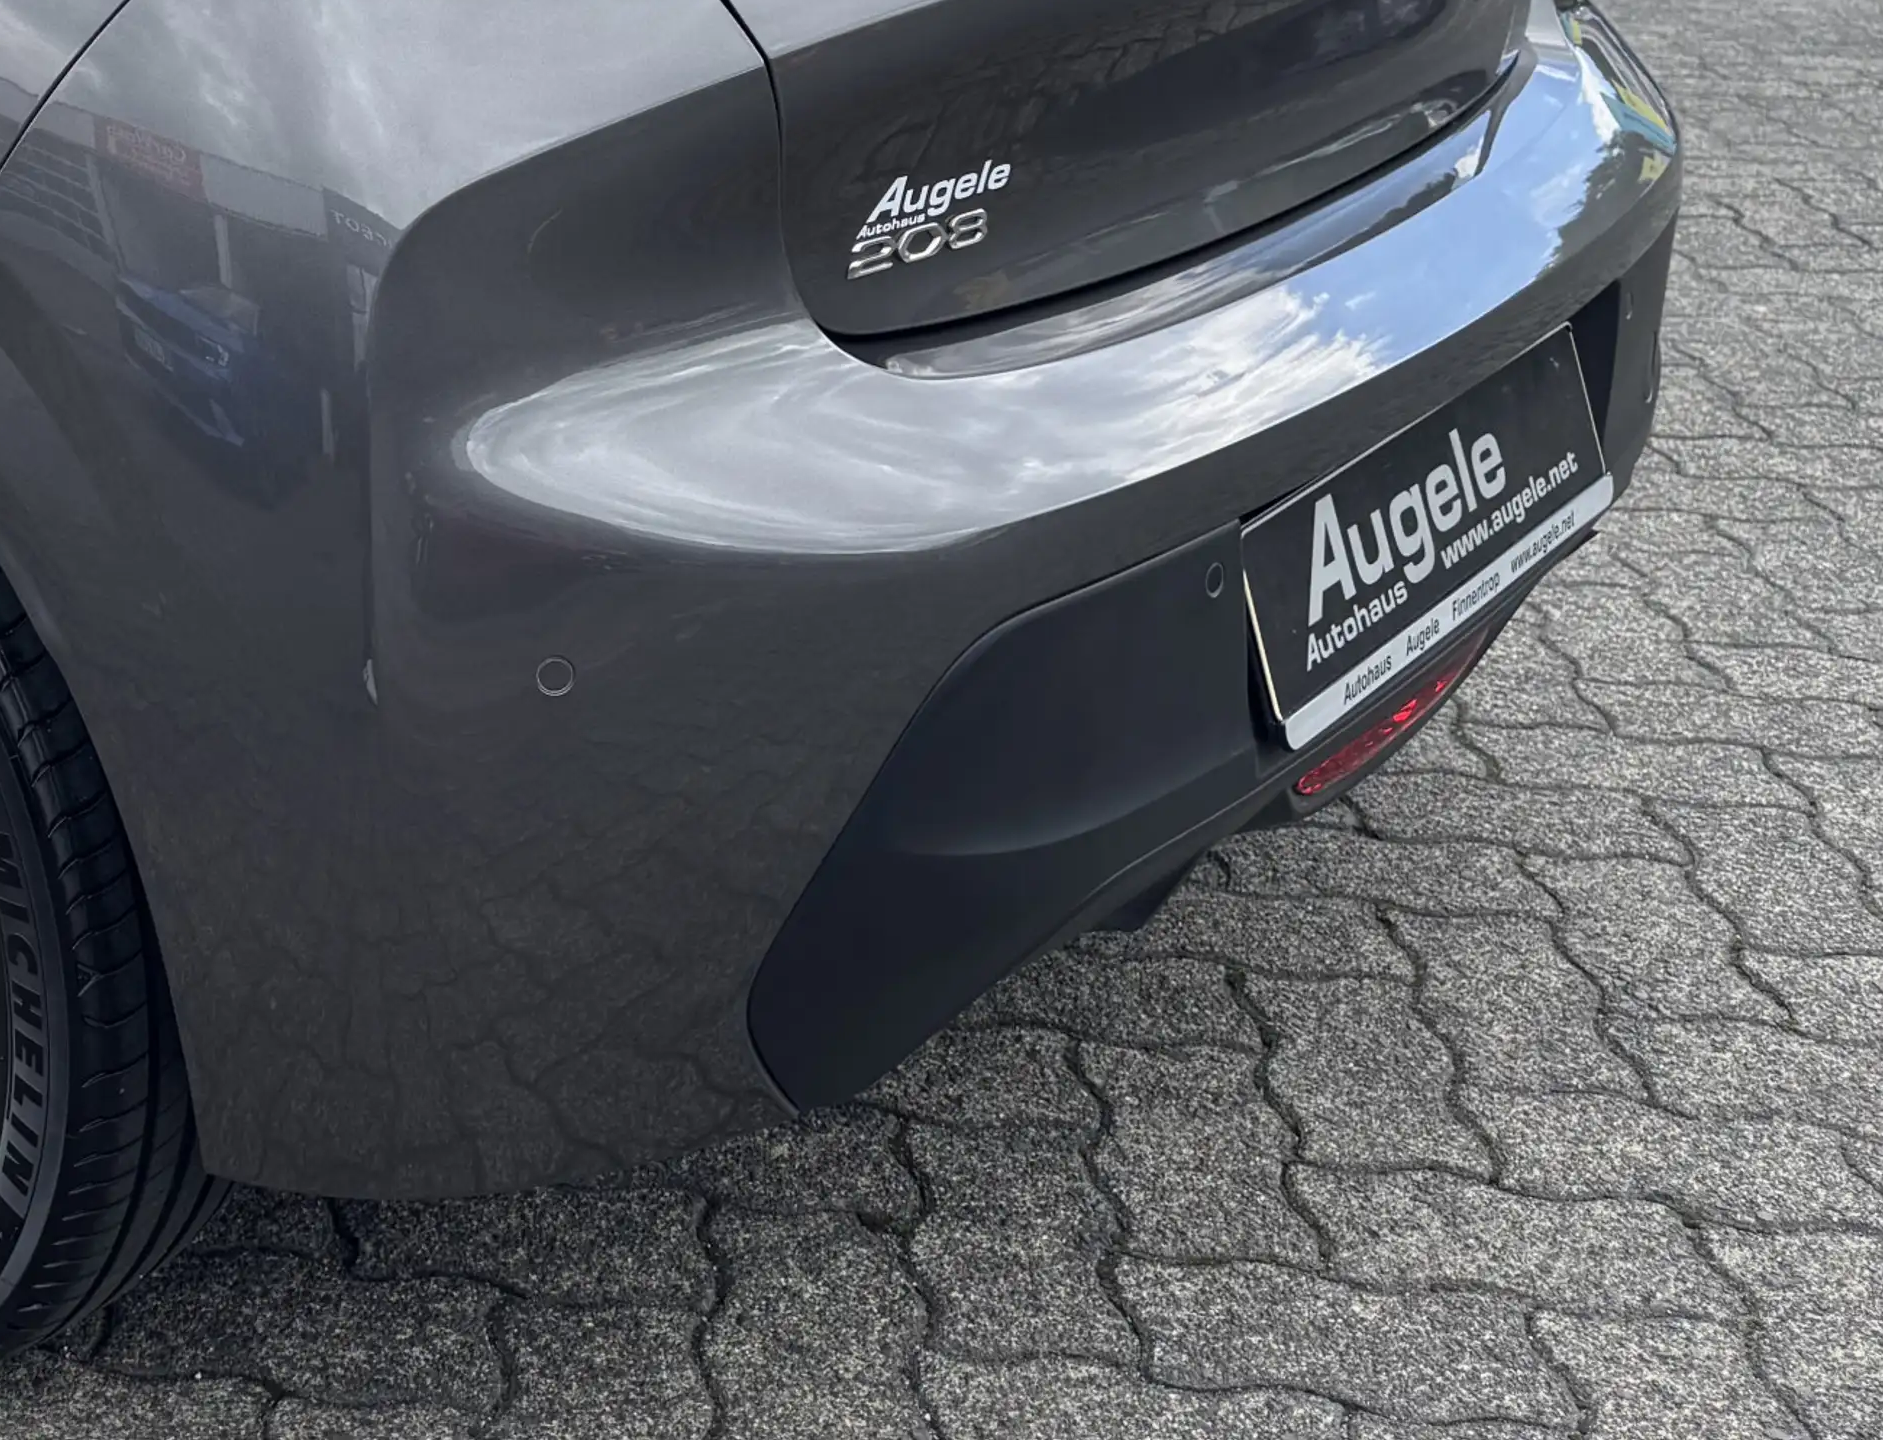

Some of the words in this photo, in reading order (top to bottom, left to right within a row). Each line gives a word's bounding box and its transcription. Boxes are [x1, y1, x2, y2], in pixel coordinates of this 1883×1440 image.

[856, 213, 926, 240] Autohaus
[866, 159, 1011, 223] Augele
[847, 208, 988, 280] 208
[1307, 428, 1507, 627] Augele
[1441, 451, 1579, 570] www.augele.net
[1307, 581, 1409, 672] Autohaus
[1343, 654, 1392, 706] Autohaus
[1406, 616, 1440, 657] Augele
[1452, 571, 1501, 622] Finnentrop
[1510, 510, 1576, 575] www.augele.net
